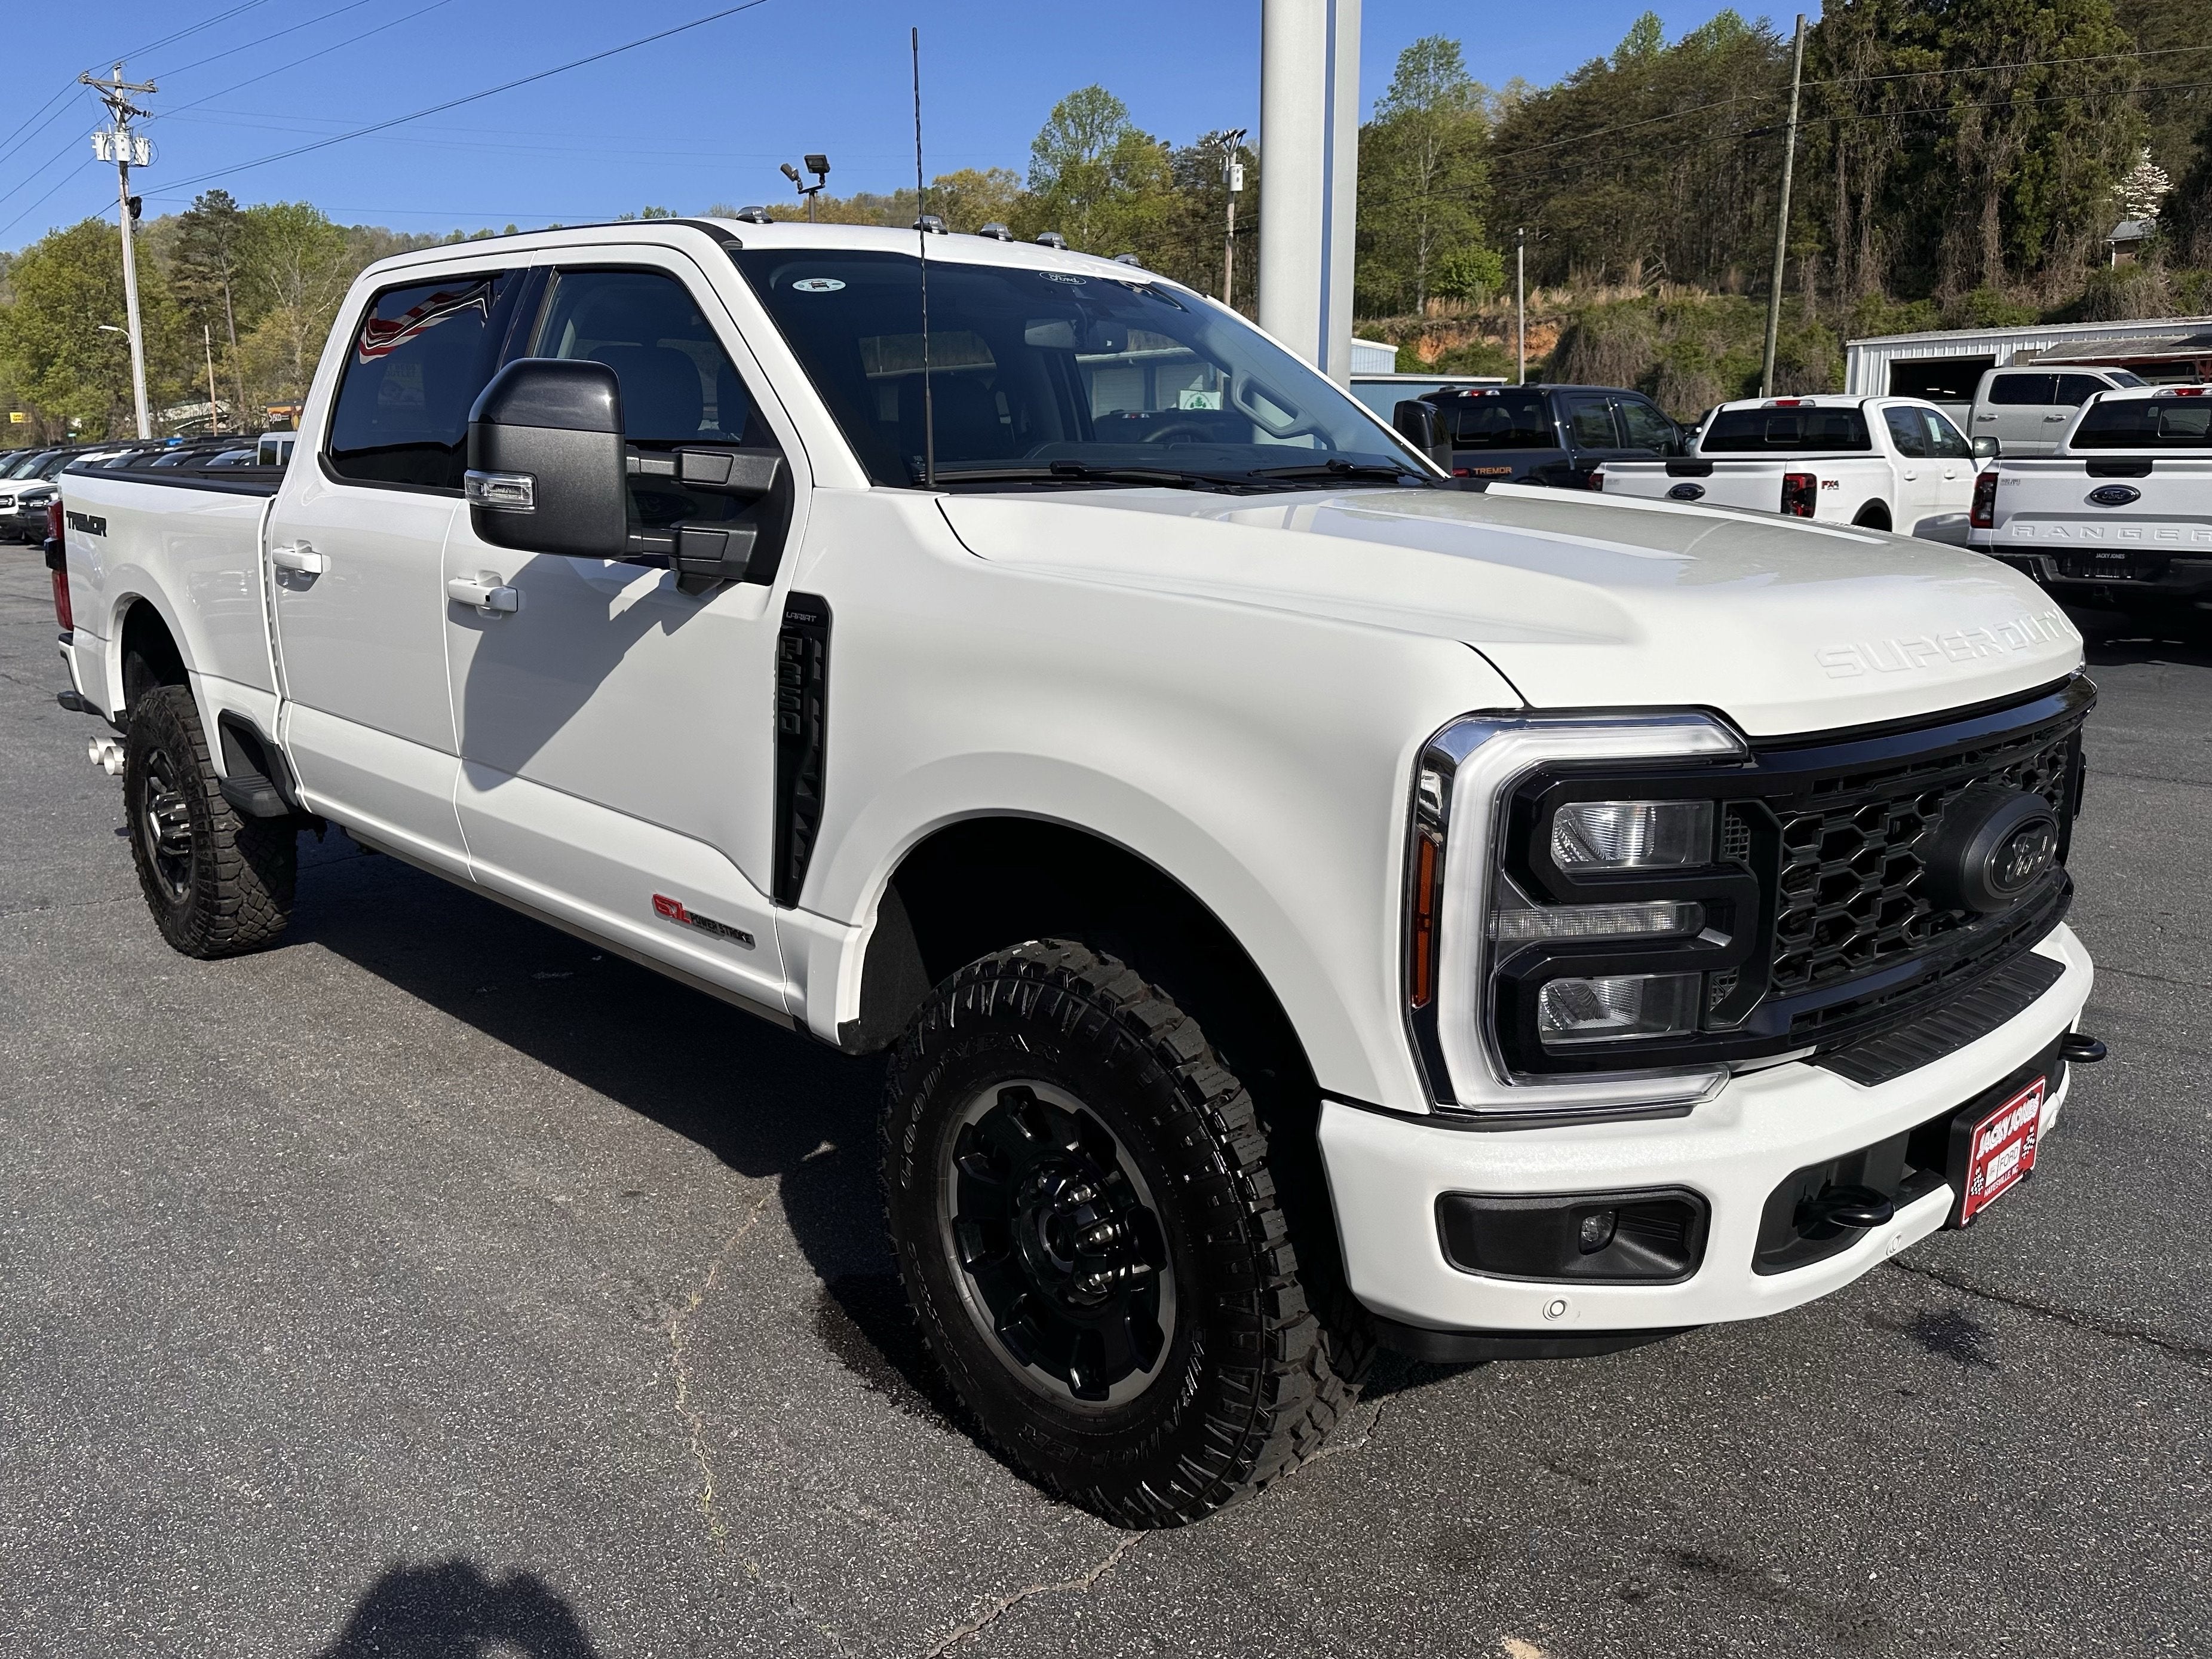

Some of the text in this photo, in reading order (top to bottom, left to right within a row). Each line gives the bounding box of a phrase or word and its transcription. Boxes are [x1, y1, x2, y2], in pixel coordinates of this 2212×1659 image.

[1048, 273, 1079, 283] Ford
[1473, 467, 1512, 475] TREMOR
[1821, 480, 1839, 489] FX4
[66, 510, 107, 538] TREMOR
[2012, 525, 2212, 541] RANGER
[786, 611, 817, 622] LARIAT
[1814, 608, 2080, 679] SUPER DUTY
[2005, 829, 2048, 883] Ford
[899, 1032, 1061, 1191] GOODYEAR
[1976, 1093, 2040, 1161] JACKY JONES
[1999, 1146, 2019, 1170] FORD
